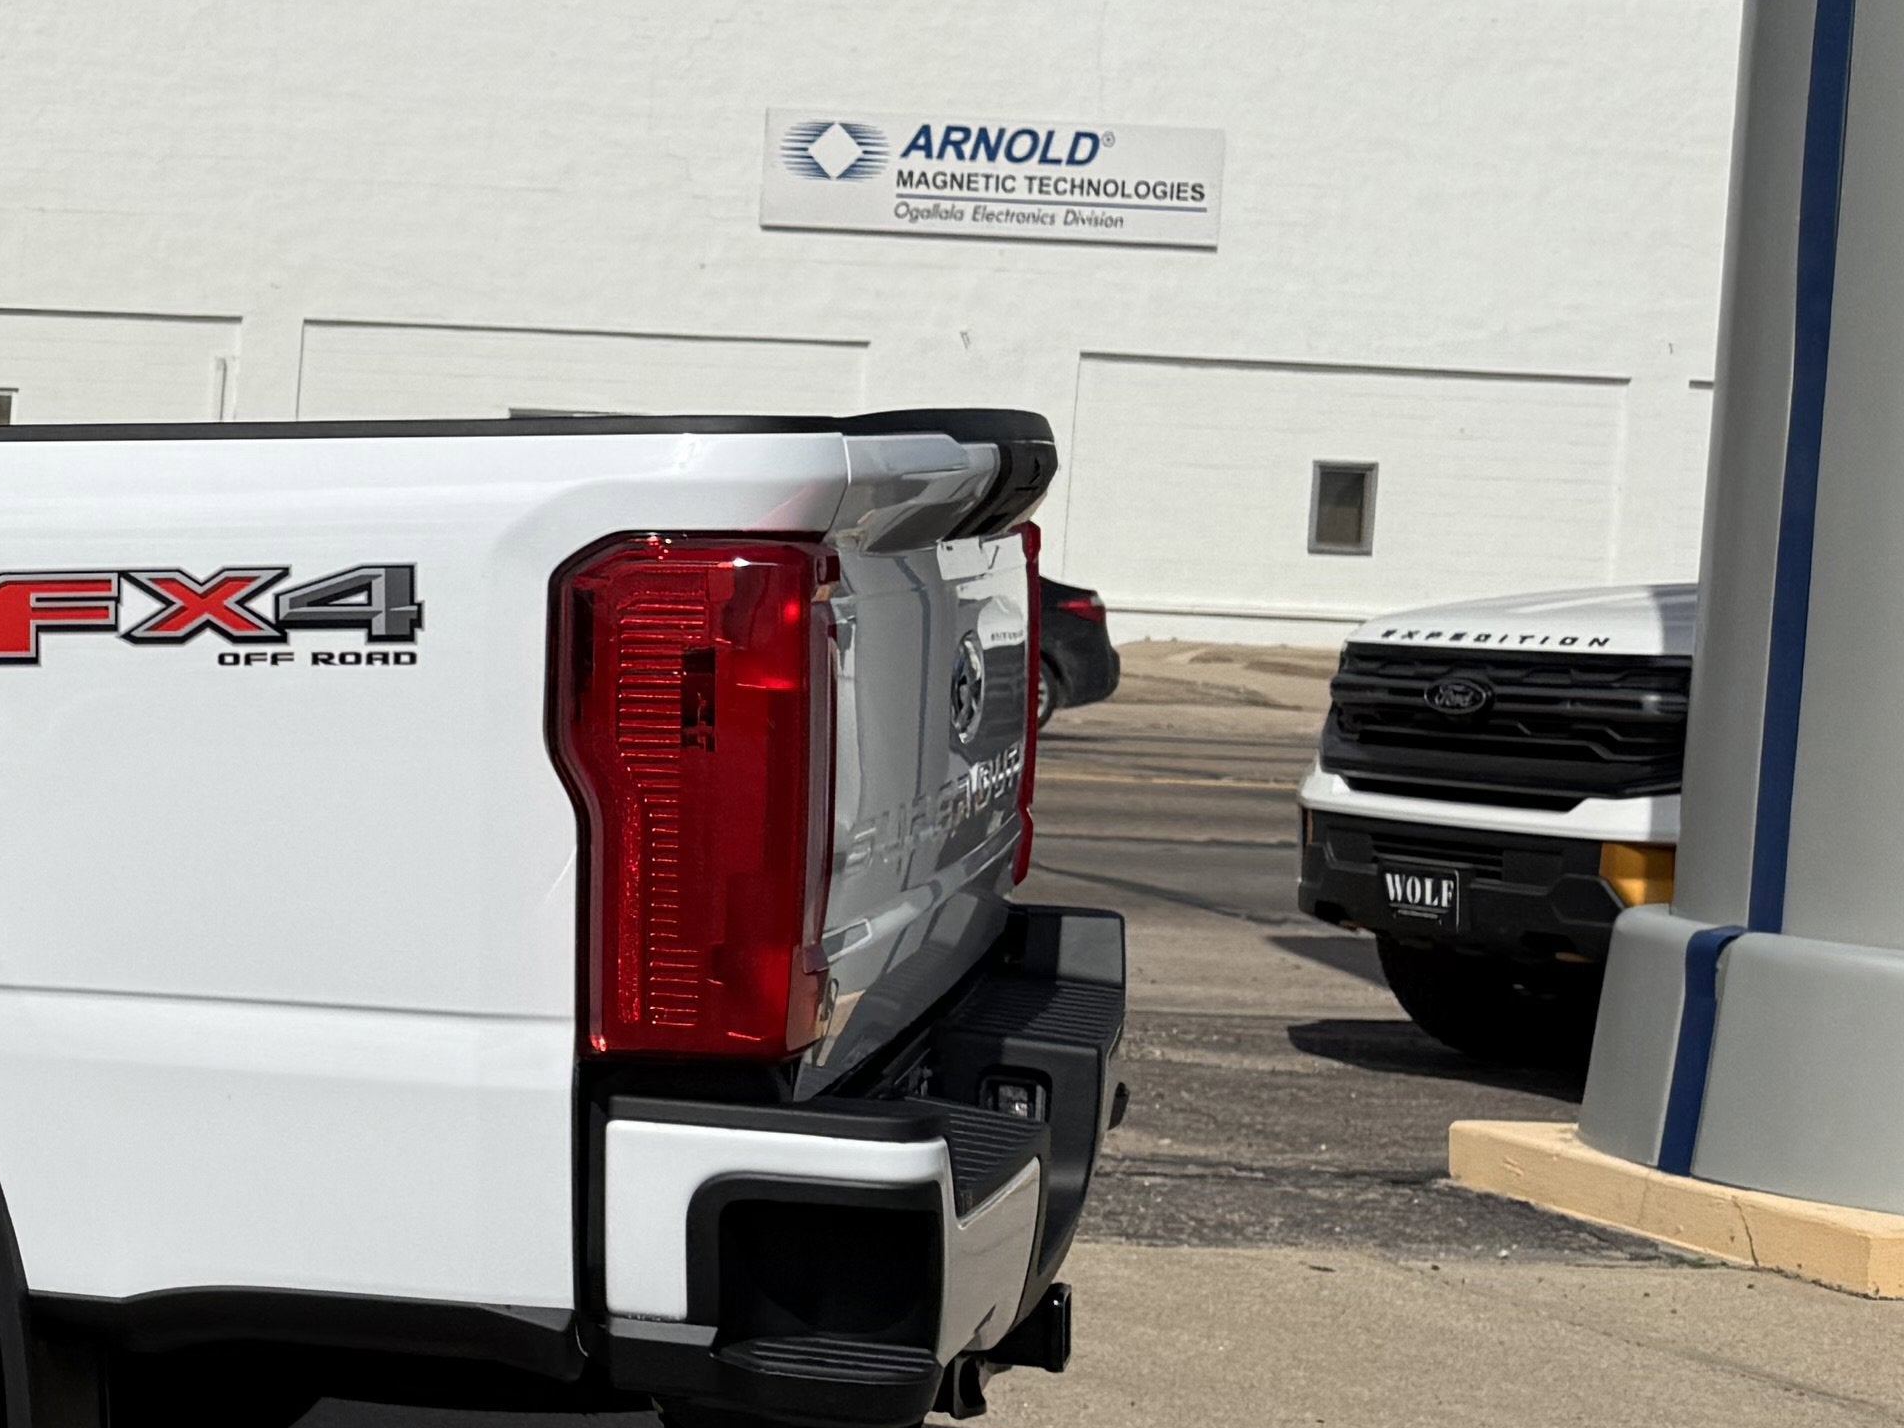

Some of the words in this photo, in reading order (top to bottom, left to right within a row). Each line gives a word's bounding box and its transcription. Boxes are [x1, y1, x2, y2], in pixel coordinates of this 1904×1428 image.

[900, 123, 1101, 166] ARNOLD
[895, 169, 1016, 194] MAGNETIC
[1023, 175, 1206, 202] TECHNOLOGIES
[894, 200, 964, 224] Ogallala
[971, 205, 1056, 227] Electronics
[1063, 209, 1125, 229] Division
[1381, 629, 1610, 647] EXPEDITION
[217, 651, 295, 666] OFF
[310, 651, 417, 666] ROAD
[1385, 873, 1454, 907] WOLF
